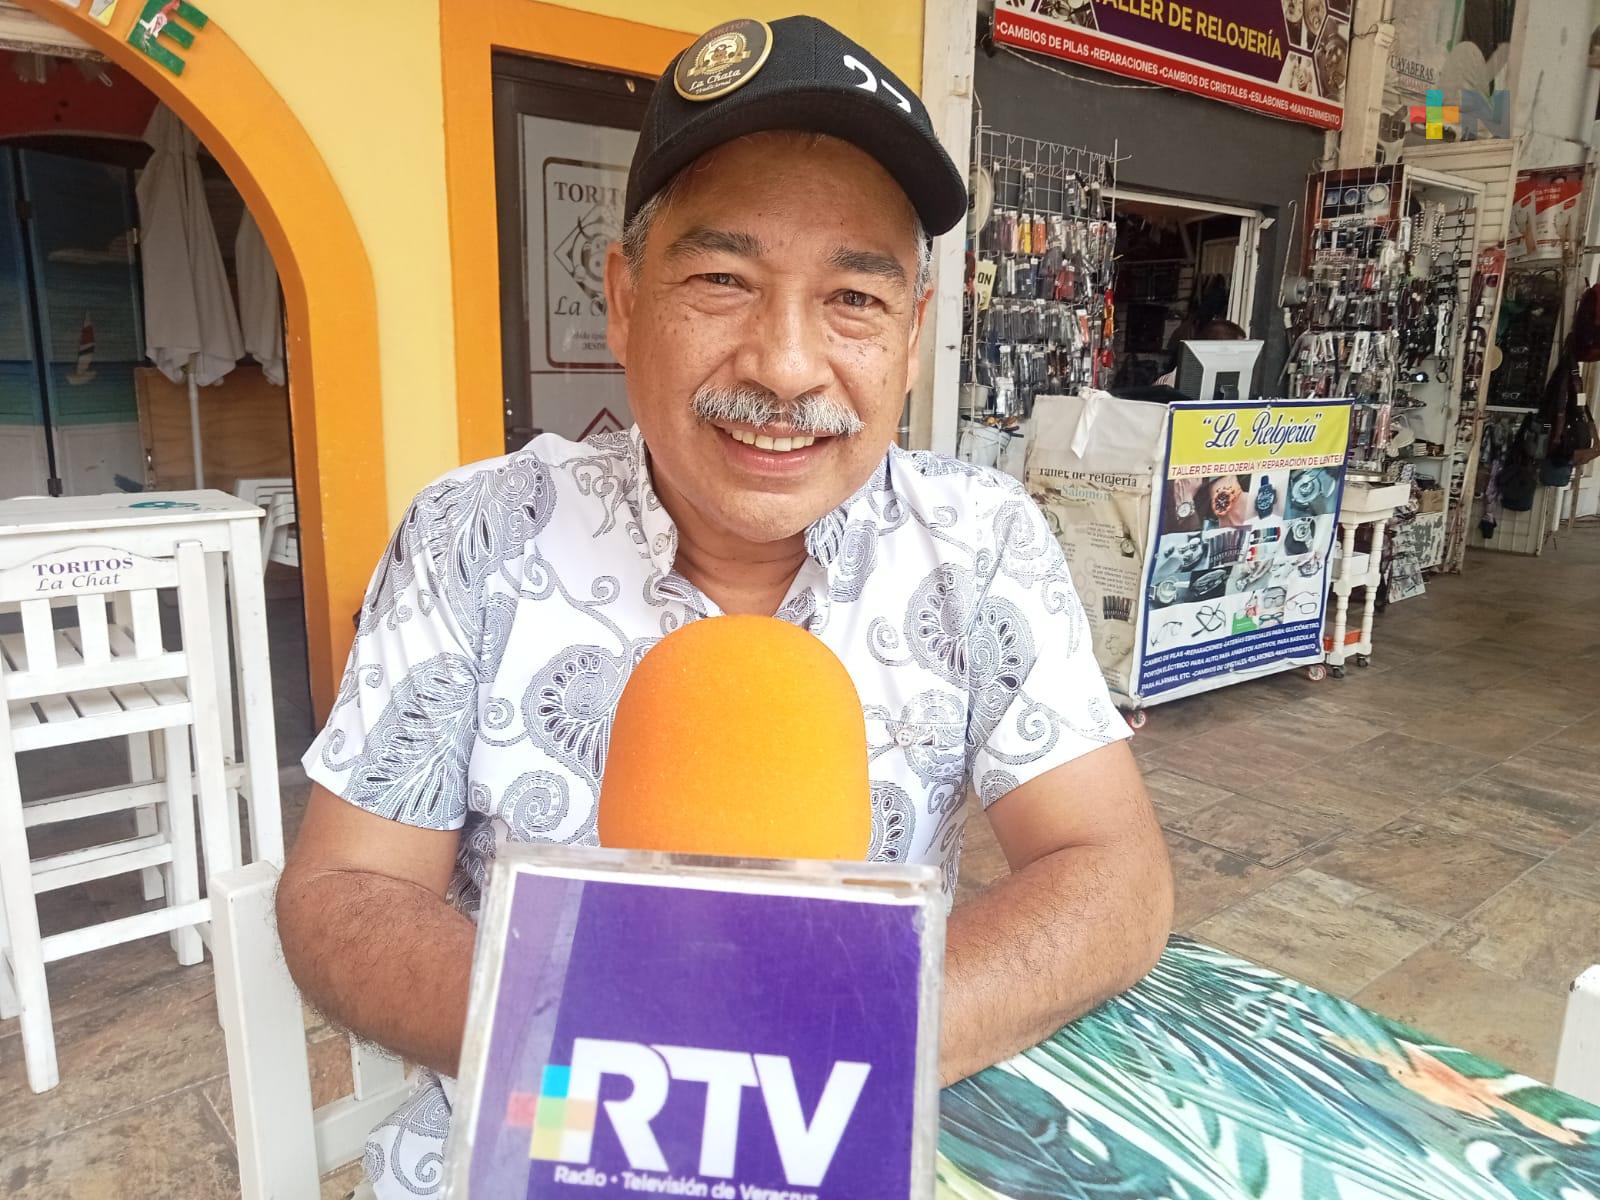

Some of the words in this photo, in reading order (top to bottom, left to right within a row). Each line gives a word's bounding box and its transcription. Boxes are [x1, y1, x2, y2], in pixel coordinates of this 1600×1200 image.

[1094, 0, 1166, 28] LLER
[1168, 2, 1193, 32] DE
[1195, 11, 1283, 61] RELOJERÍA
[688, 80, 705, 92] La
[706, 68, 742, 84] Chata
[998, 21, 1048, 46] CAMBIOS
[1048, 34, 1062, 49] DE
[1062, 39, 1090, 57] PILAS
[1093, 46, 1159, 75] REPARACIONES
[1161, 66, 1199, 87] CAMBIOS
[1199, 76, 1210, 89] DE
[1210, 79, 1249, 99] CRISTALES
[1250, 91, 1290, 110] ESLABONES
[1291, 103, 1341, 125] MANTENIMIENTO
[553, 295, 582, 317] La
[1171, 465, 1201, 477] TALLER
[1201, 464, 1212, 474] DE
[1256, 461, 1262, 470] Y
[1308, 456, 1319, 466] DE
[1319, 454, 1344, 465] LENTES
[32, 557, 134, 576] TORITOS
[36, 578, 63, 592] La
[72, 571, 121, 588] Chat
[562, 1036, 872, 1188] RTV
[554, 1164, 607, 1188] Radio
[620, 1171, 708, 1200] Televisión
[711, 1182, 736, 1200] de
